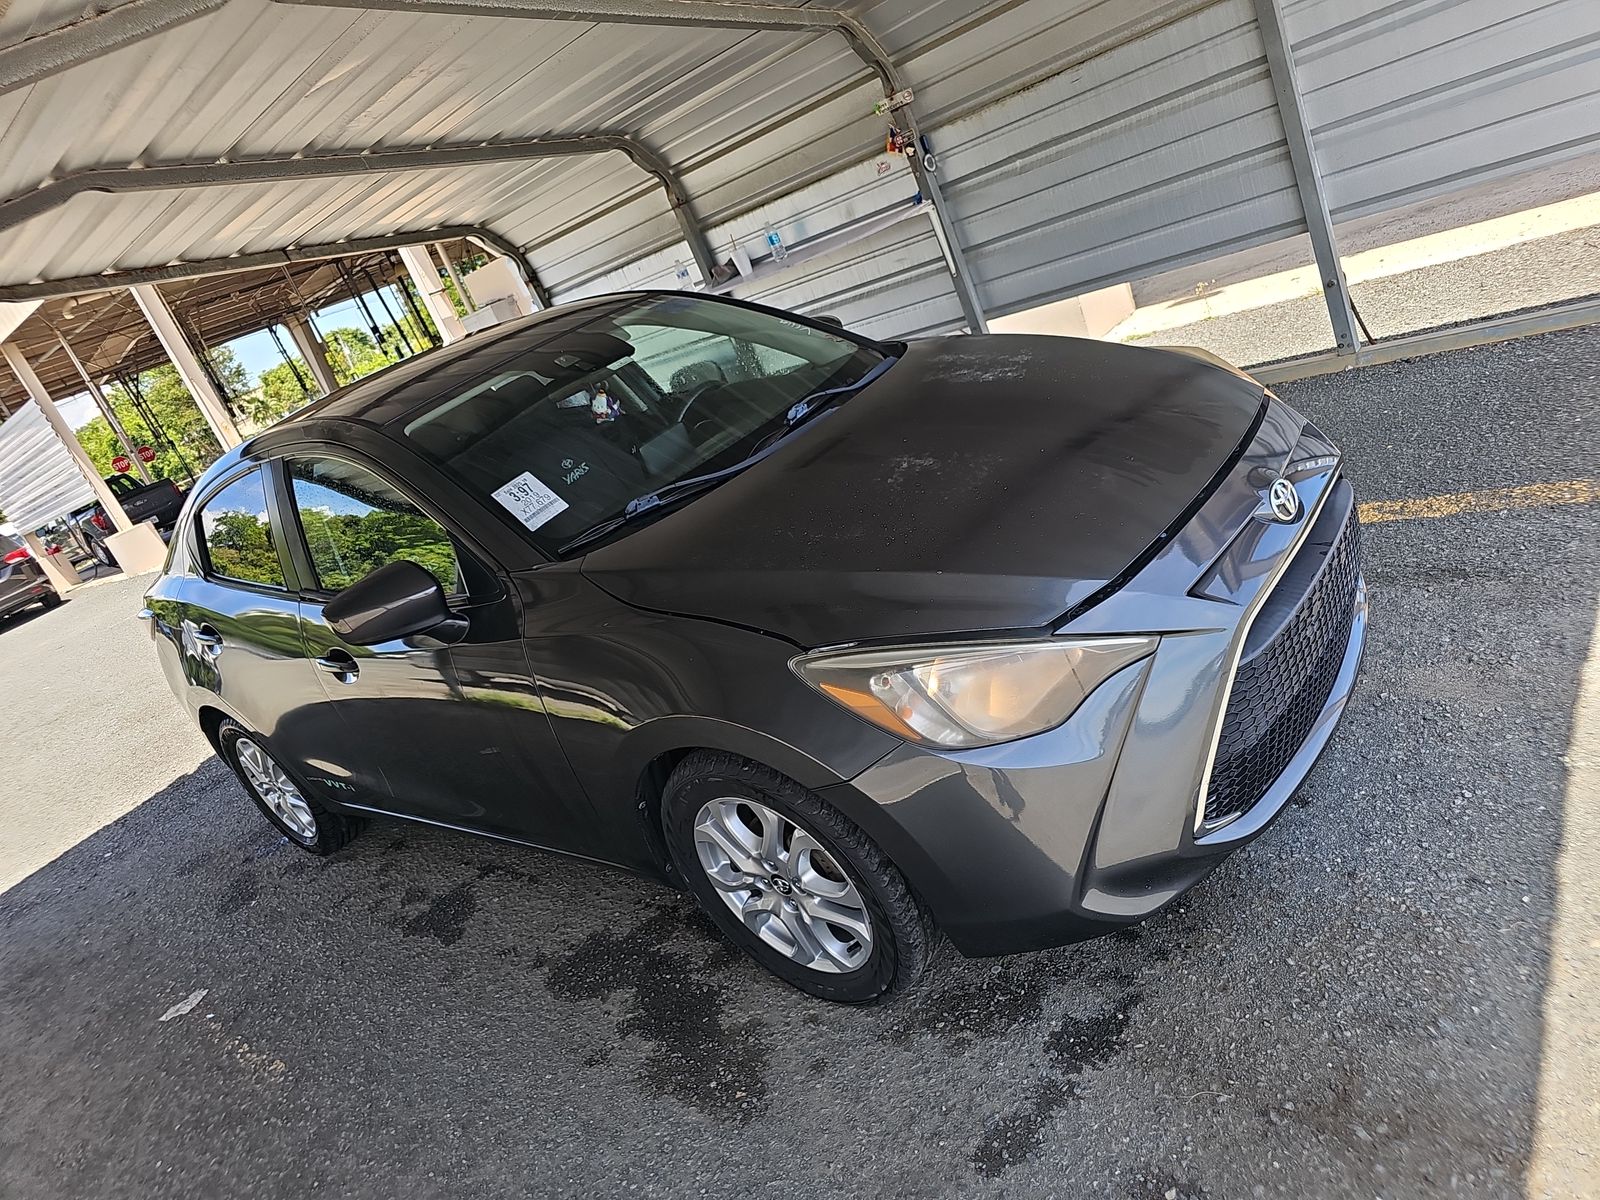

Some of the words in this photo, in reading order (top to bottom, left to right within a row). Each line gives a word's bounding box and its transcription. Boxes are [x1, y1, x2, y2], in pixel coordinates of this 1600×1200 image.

[139, 449, 154, 460] STOP
[112, 459, 129, 471] STOP
[521, 491, 540, 507] 2019
